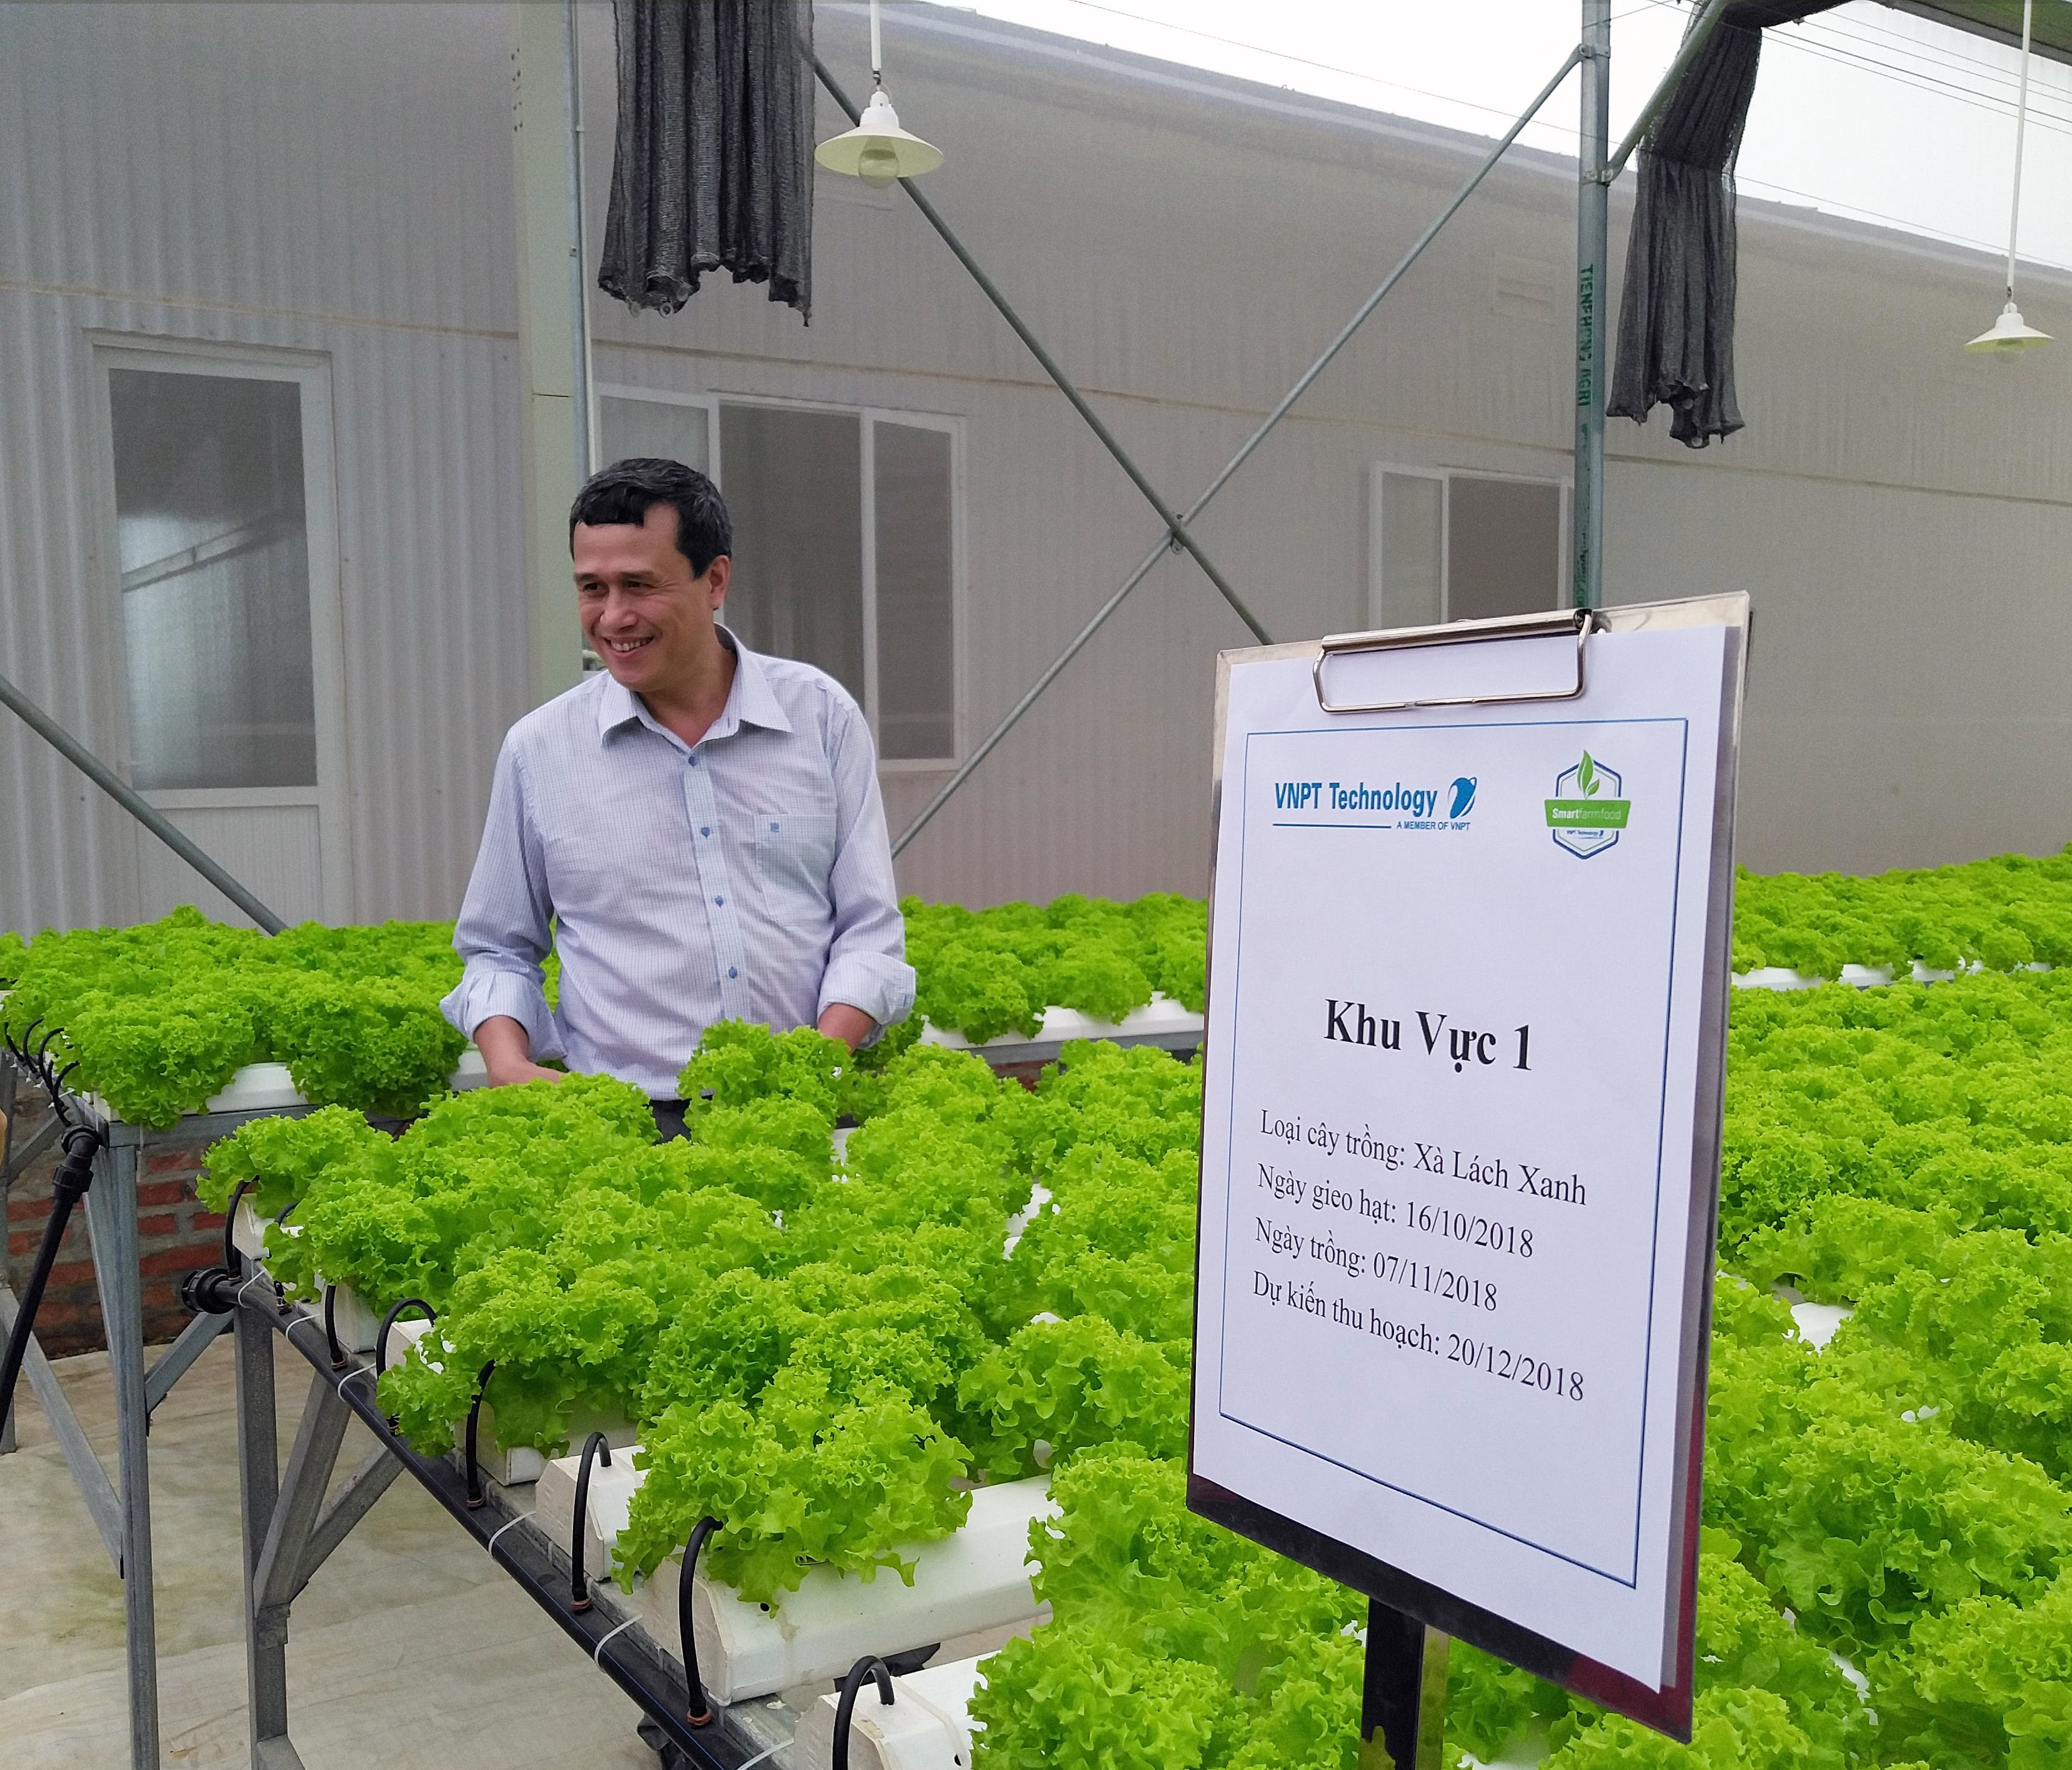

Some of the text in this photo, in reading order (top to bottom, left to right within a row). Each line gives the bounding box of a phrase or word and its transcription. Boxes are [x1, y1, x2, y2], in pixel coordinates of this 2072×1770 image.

[1275, 782, 1438, 818] VNPT Technology
[1397, 821, 1471, 831] A MEMBER OF VNPT
[1323, 999, 1532, 1073] Khu Vực 1
[1260, 1109, 1587, 1206] Loại cây trồng: Xà Lách Xanh
[1257, 1162, 1533, 1258] Ngày gieo hạt: 16/10/2018
[1255, 1216, 1498, 1311] Ngày trồng: 07/11/2018
[1253, 1270, 1584, 1401] Dự kiến thu hoạch: 20/12/2018
